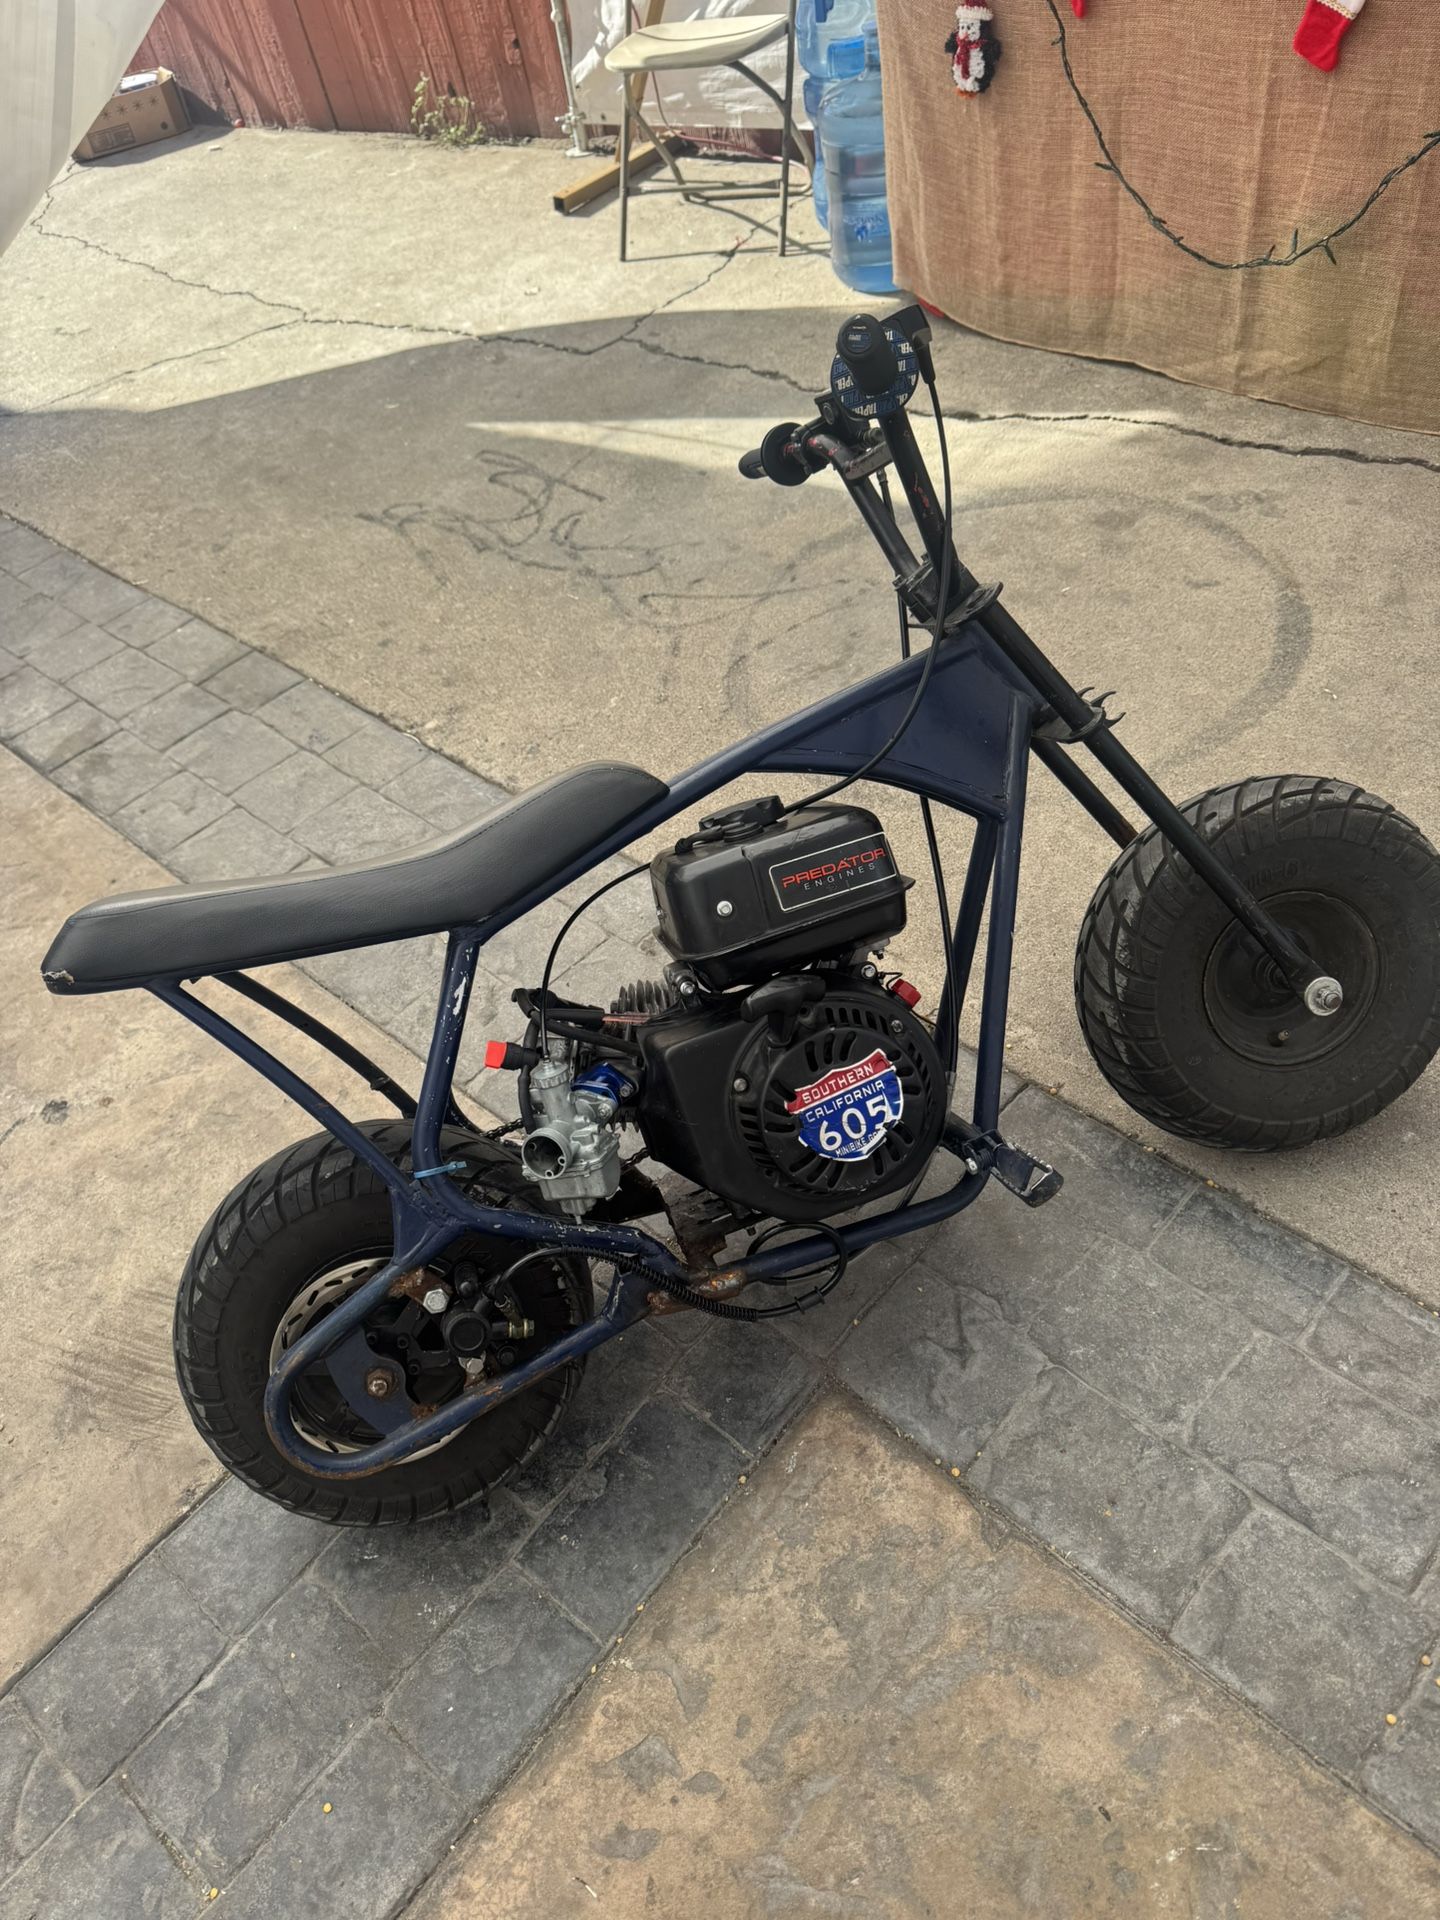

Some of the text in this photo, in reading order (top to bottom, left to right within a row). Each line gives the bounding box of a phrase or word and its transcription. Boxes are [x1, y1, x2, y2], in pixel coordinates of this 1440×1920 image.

[781, 847, 886, 889] PREDATOR
[804, 863, 876, 891] ENGINES
[802, 1063, 875, 1105] SOUTHERN
[805, 1079, 885, 1123] CALIFORNIA
[819, 1094, 889, 1152] 605
[835, 1136, 870, 1157] MINIBIKE
